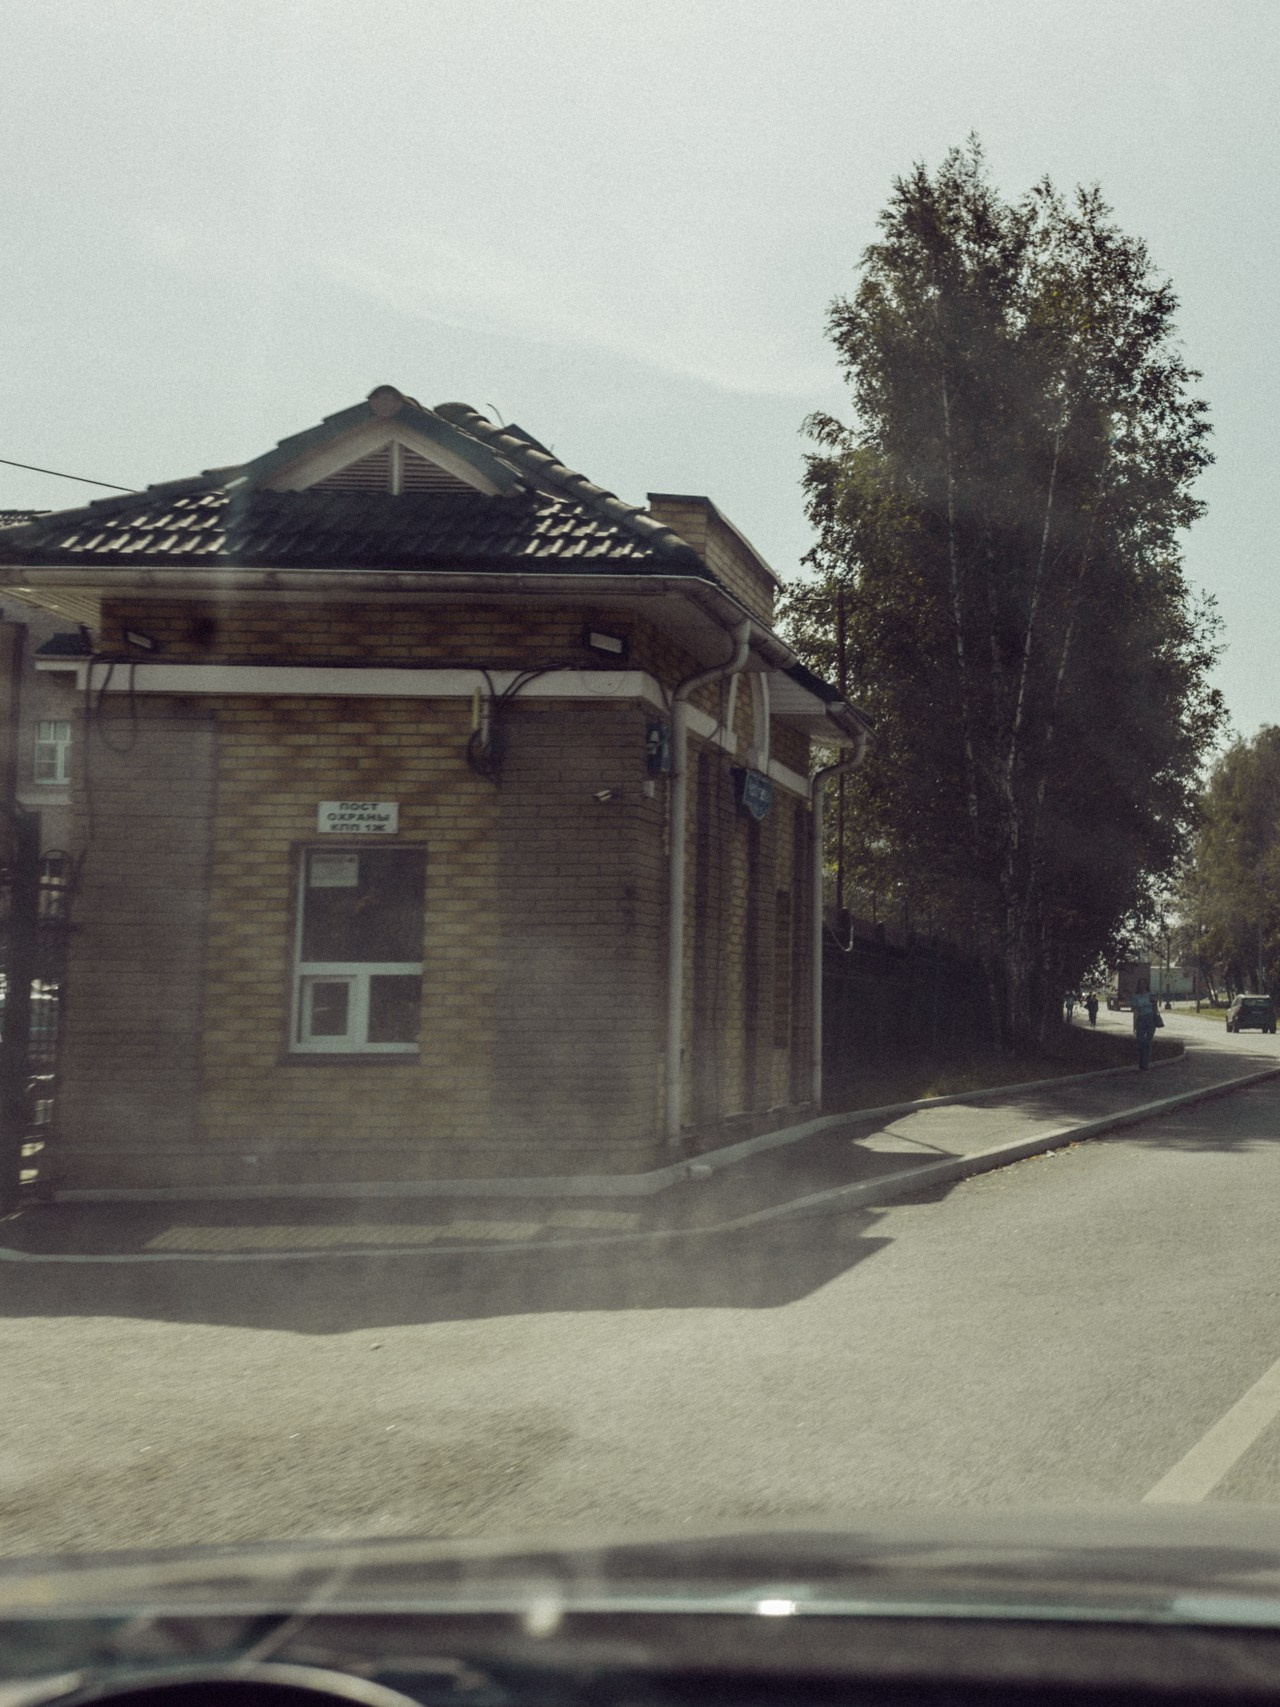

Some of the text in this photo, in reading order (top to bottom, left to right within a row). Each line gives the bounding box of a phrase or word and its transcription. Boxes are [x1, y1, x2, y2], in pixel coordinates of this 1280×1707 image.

[340, 803, 379, 811] ПОСТ
[327, 812, 390, 821] ОХРАНЫ
[330, 823, 360, 832] КПП
